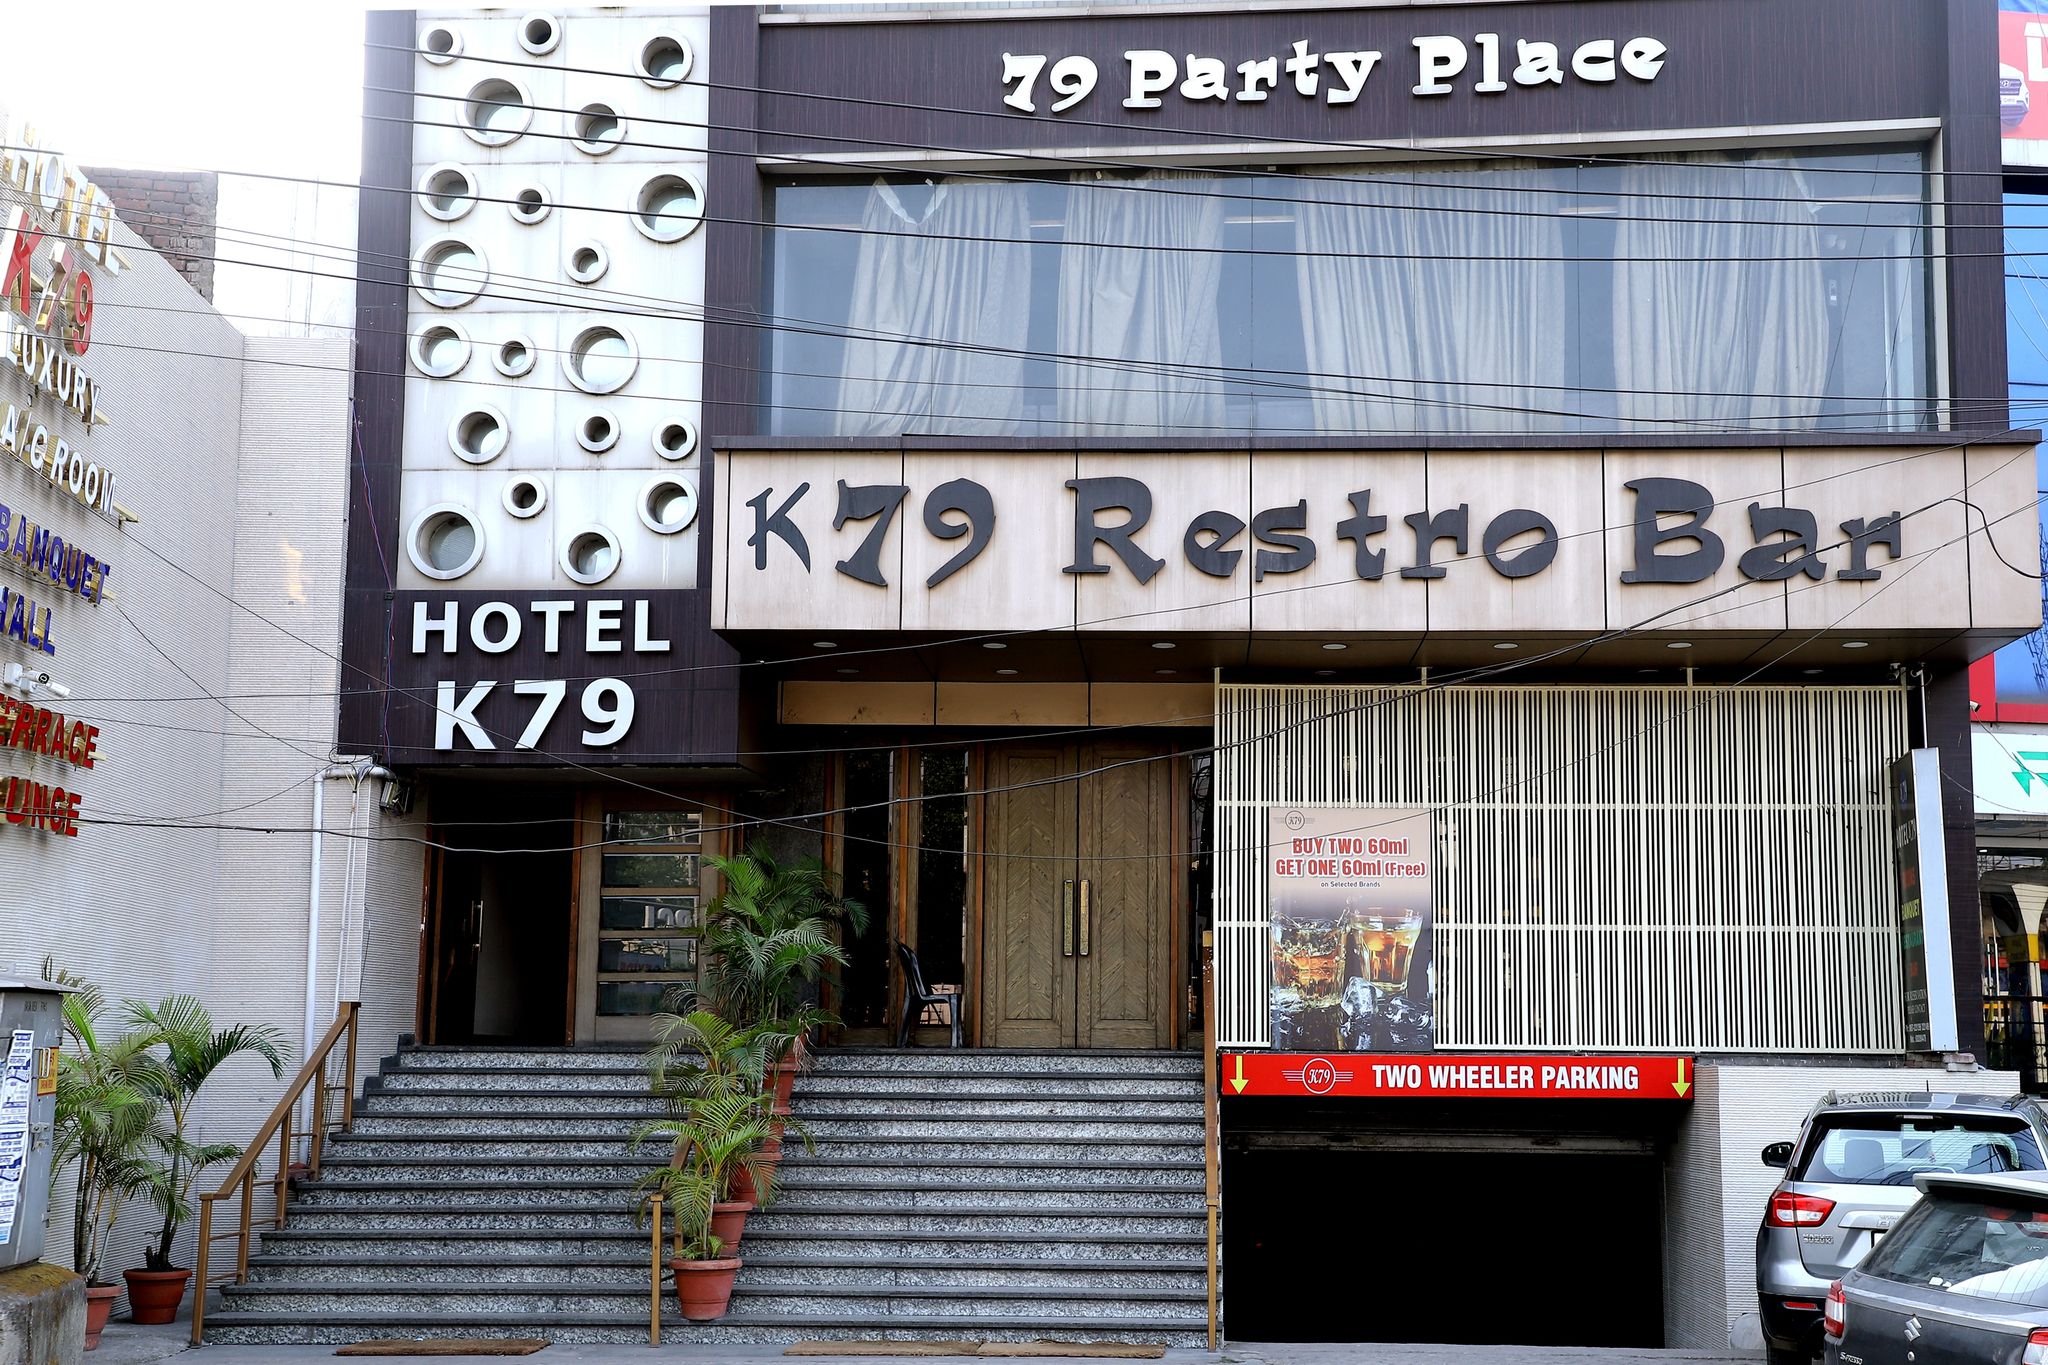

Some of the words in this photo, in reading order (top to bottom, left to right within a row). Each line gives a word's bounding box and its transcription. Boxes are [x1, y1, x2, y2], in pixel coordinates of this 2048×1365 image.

[1002, 51, 1099, 112] 79
[1122, 40, 1381, 109] Party
[1412, 32, 1667, 96] Place
[9, 112, 121, 276] HOTEL
[2, 205, 93, 356] K79
[50, 437, 117, 515] ROOM
[0, 503, 110, 604] BANQUET
[745, 477, 996, 588] K79
[1061, 476, 1559, 586] Restro
[1619, 477, 1903, 583] Bar
[411, 599, 671, 653] HOTEL
[435, 677, 635, 750] K79
[1275, 859, 1303, 875] GET
[1308, 859, 1337, 875] ONE
[1342, 859, 1382, 875] 60ml
[1385, 862, 1426, 876] (Free)
[1292, 838, 1323, 854] BUY
[1329, 838, 1362, 854] TWO
[1368, 838, 1408, 854] 60ml
[1307, 1068, 1331, 1084] K79
[1372, 1064, 1422, 1088] TWO
[1428, 1065, 1535, 1089] WHEELER
[1541, 1066, 1639, 1090] PARKING
